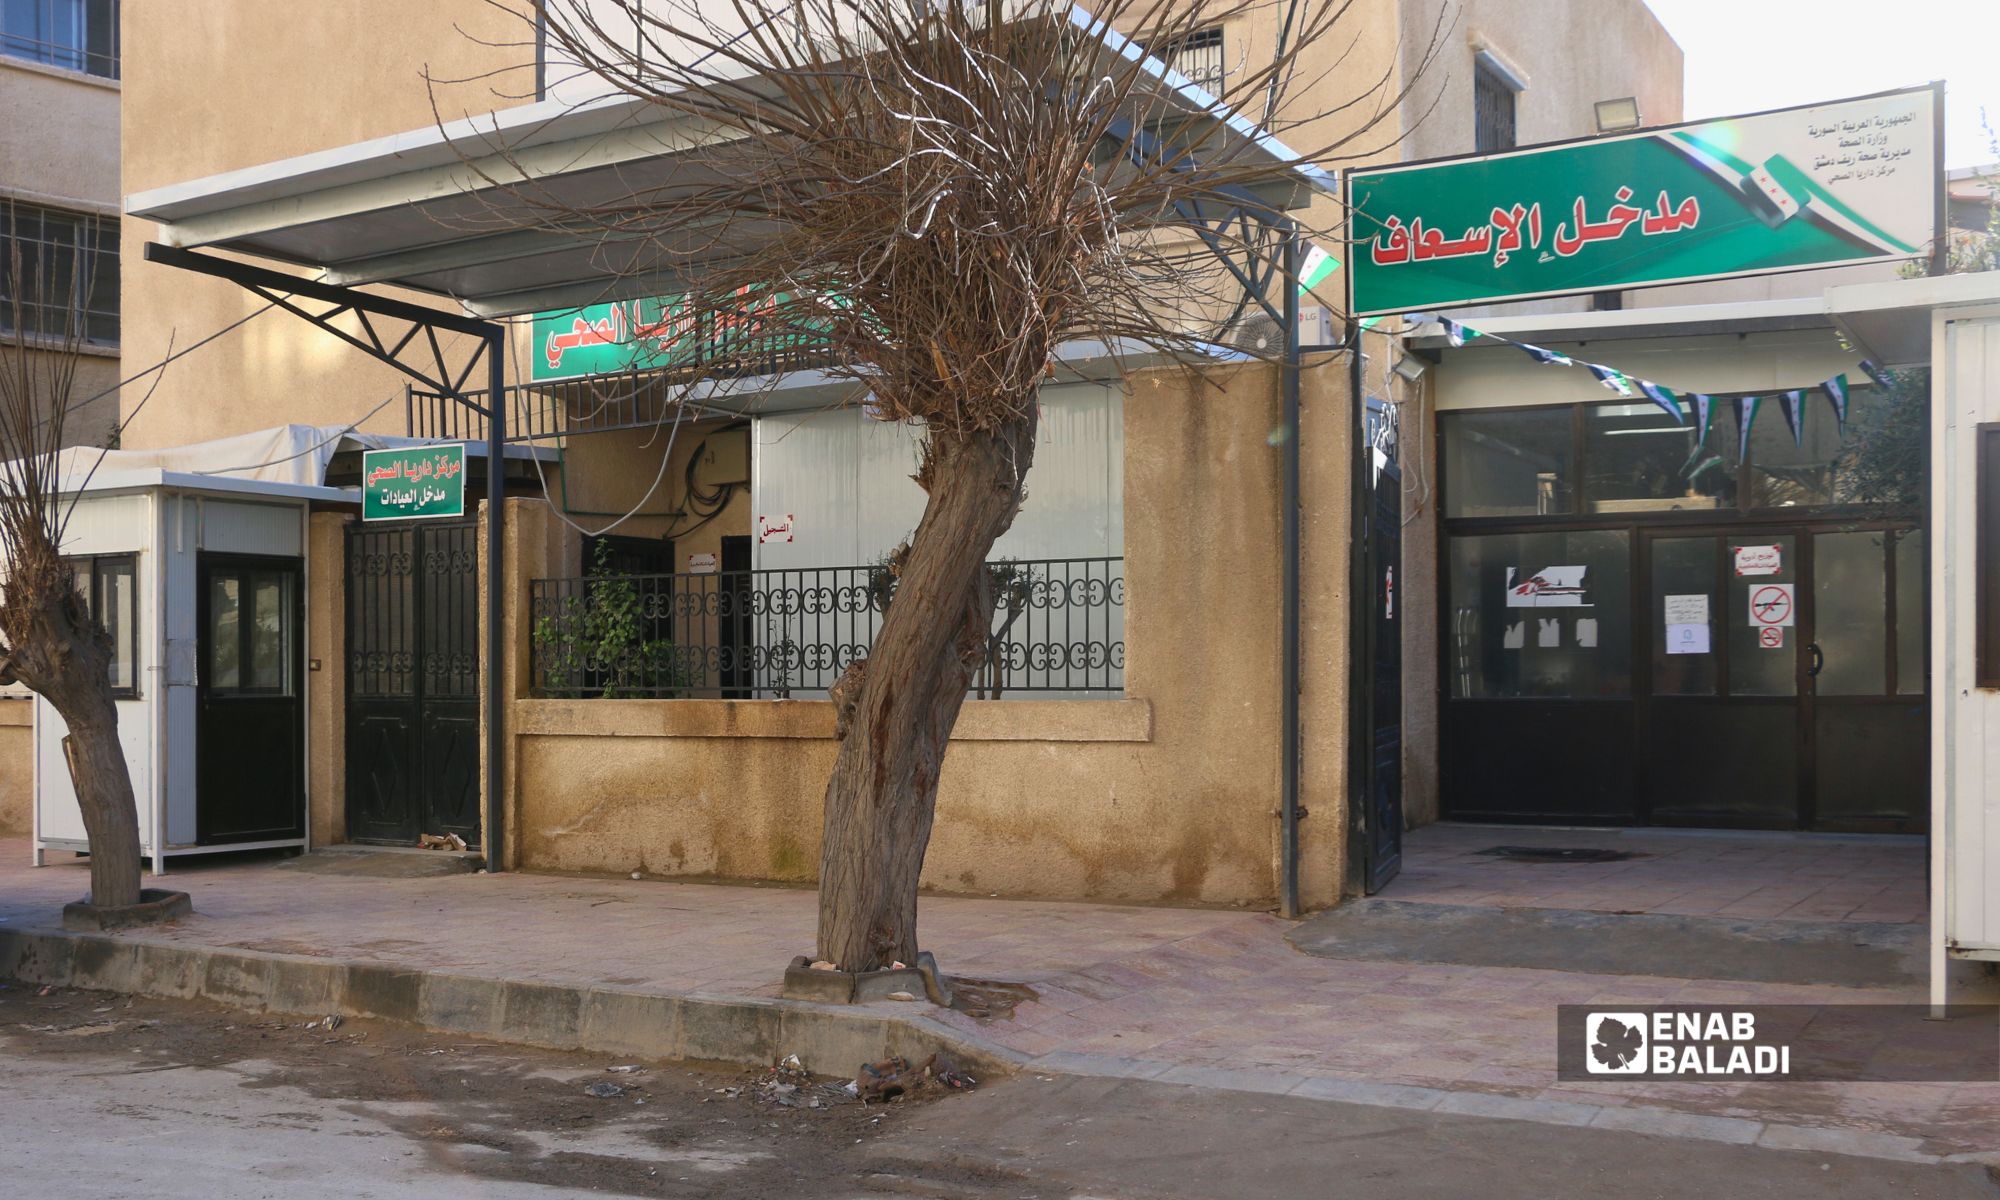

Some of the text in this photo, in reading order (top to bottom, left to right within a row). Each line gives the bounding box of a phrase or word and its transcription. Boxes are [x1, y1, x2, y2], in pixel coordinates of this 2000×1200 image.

[1808, 112, 1916, 139] الجمهورية العربية السورية
[1838, 132, 1888, 148] وزارة الصحة
[1814, 148, 1911, 171] مديرية صحة ريف دمشق
[1828, 165, 1896, 185] مركز داريا الصحي
[1371, 185, 1700, 268] مدخل الإسعاف
[545, 301, 628, 369] الصحي
[367, 455, 461, 488] مركز داريا الصحي
[380, 485, 446, 508] مدخل العيادات
[763, 522, 789, 537] التسجيل
